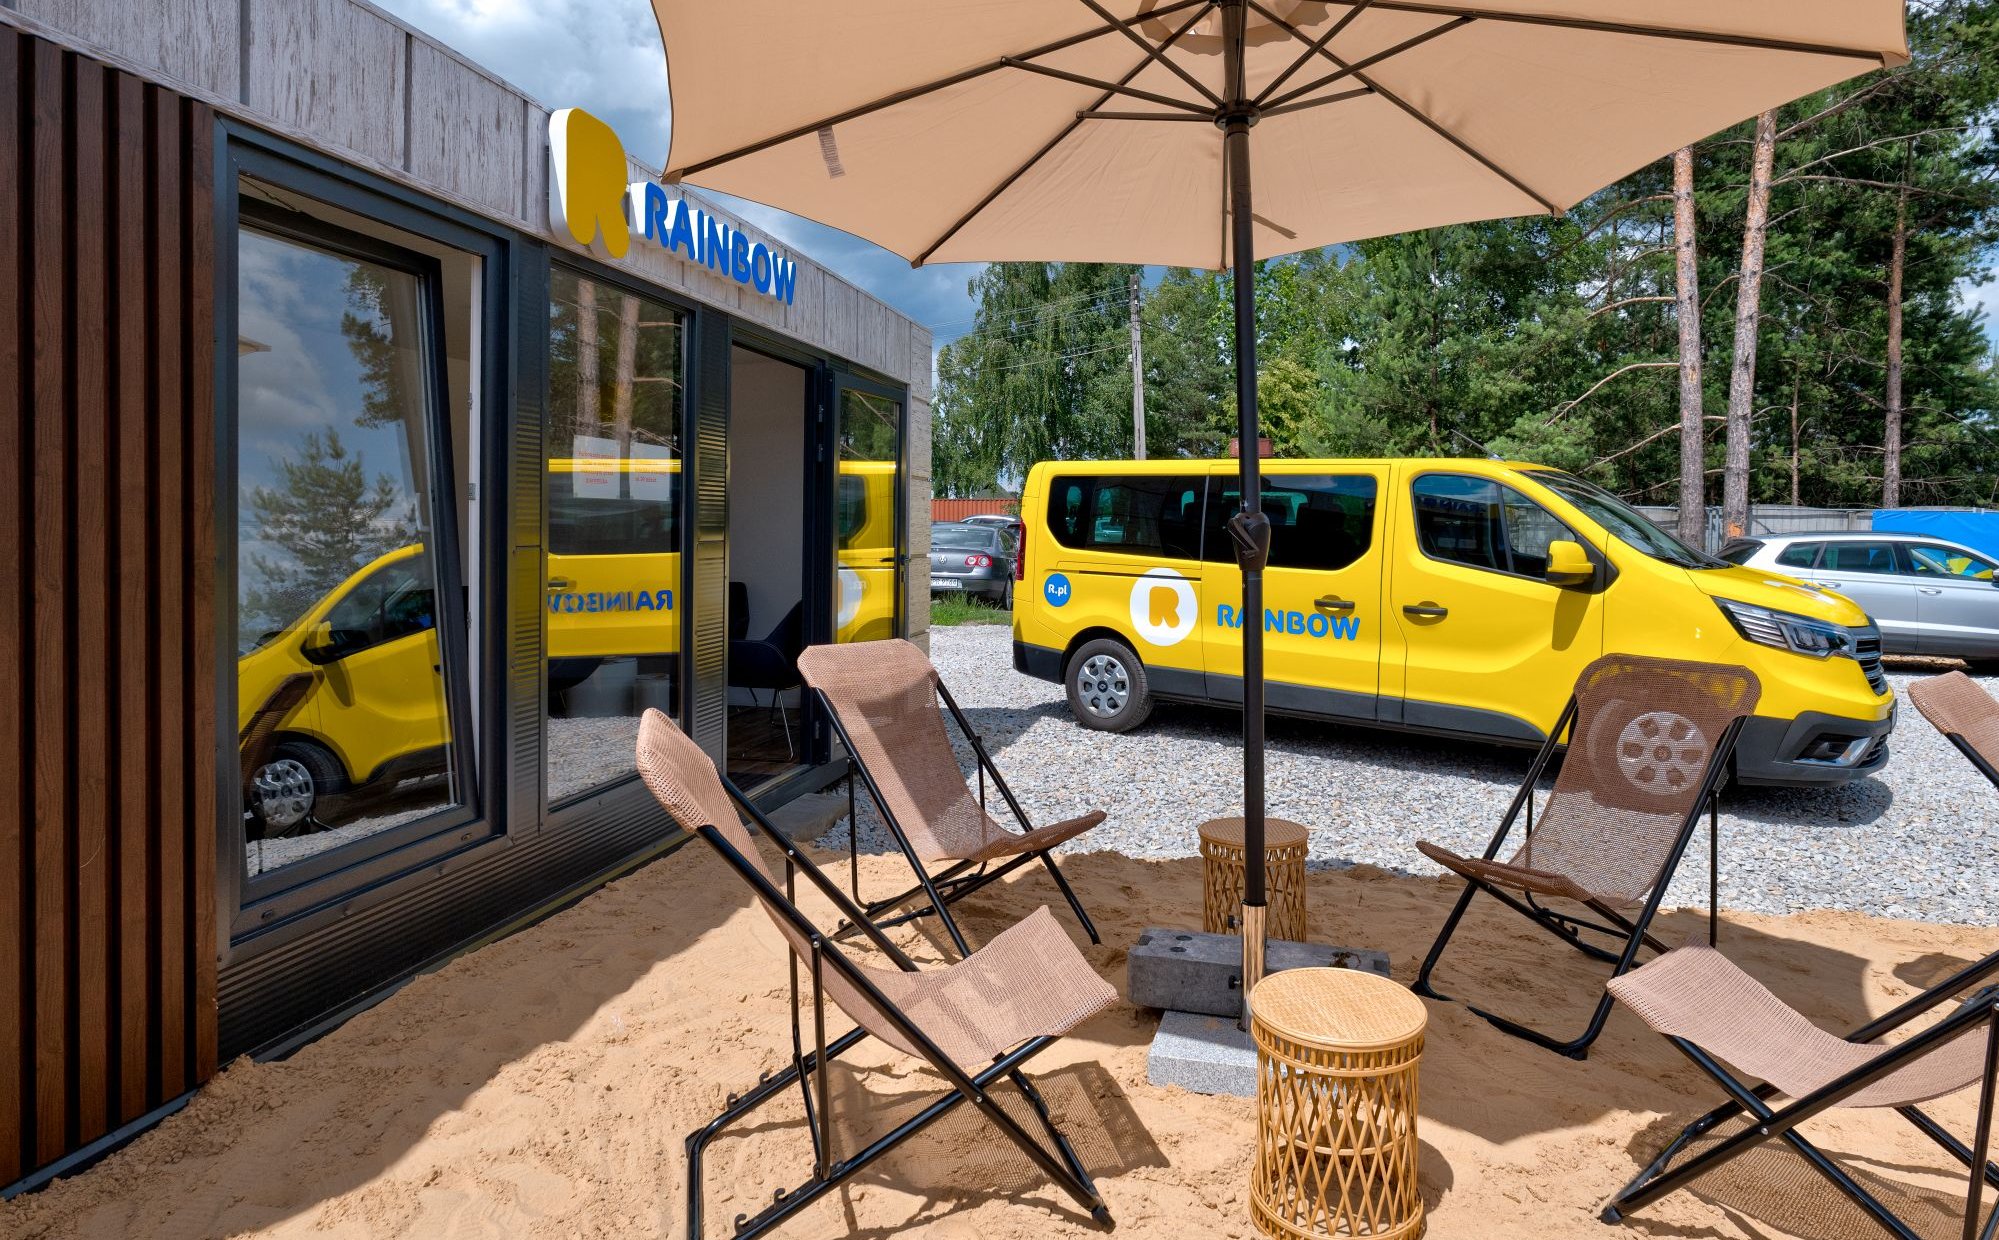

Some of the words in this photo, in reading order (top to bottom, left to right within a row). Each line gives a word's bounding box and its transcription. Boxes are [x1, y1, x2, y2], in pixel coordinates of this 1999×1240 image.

[566, 107, 630, 259] R
[644, 181, 797, 306] RAINBOW
[1047, 583, 1068, 597] R.pl
[1149, 585, 1181, 629] R
[1217, 603, 1361, 641] RNBOW
